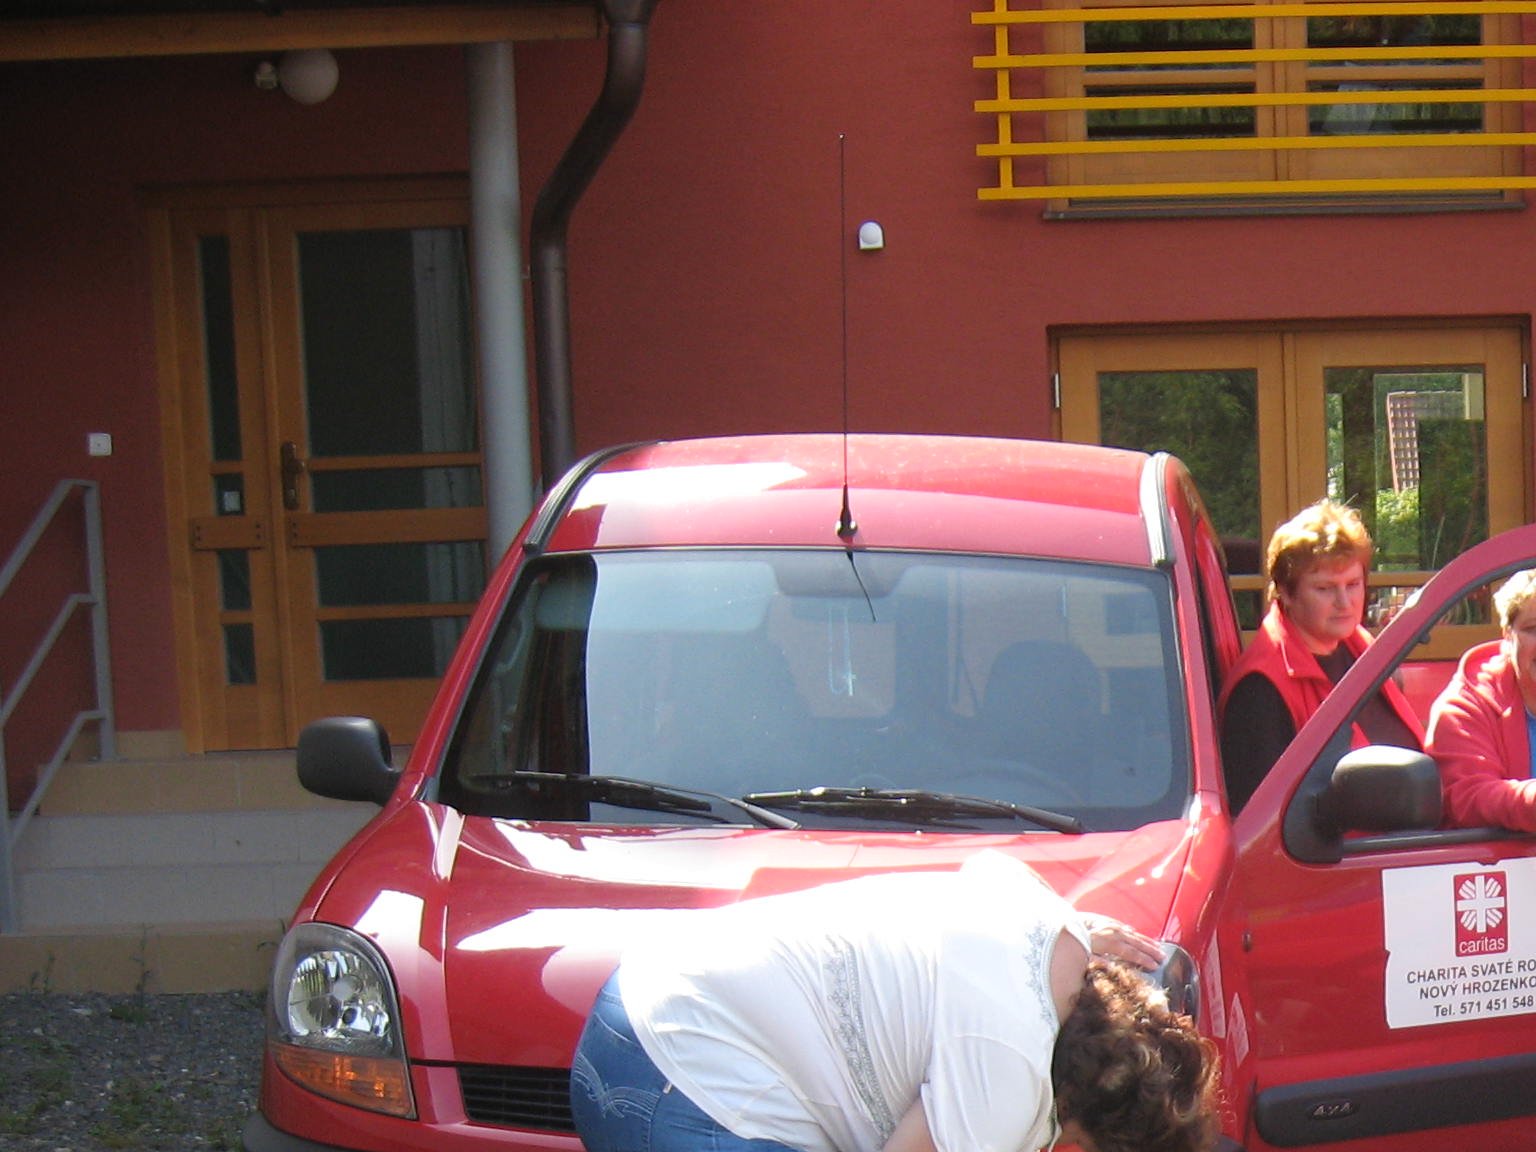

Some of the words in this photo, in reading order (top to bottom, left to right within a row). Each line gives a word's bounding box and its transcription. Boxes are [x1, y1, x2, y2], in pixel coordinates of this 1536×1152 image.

[1459, 937, 1505, 953] caritas
[1406, 966, 1467, 984] CHARITA
[1471, 958, 1514, 978] SVATÉ
[1419, 981, 1459, 1000] NOVÝ
[1433, 1003, 1456, 1018] Tel.
[1460, 1000, 1482, 1015] 571
[1486, 997, 1508, 1012] 451
[1512, 994, 1534, 1009] 548
